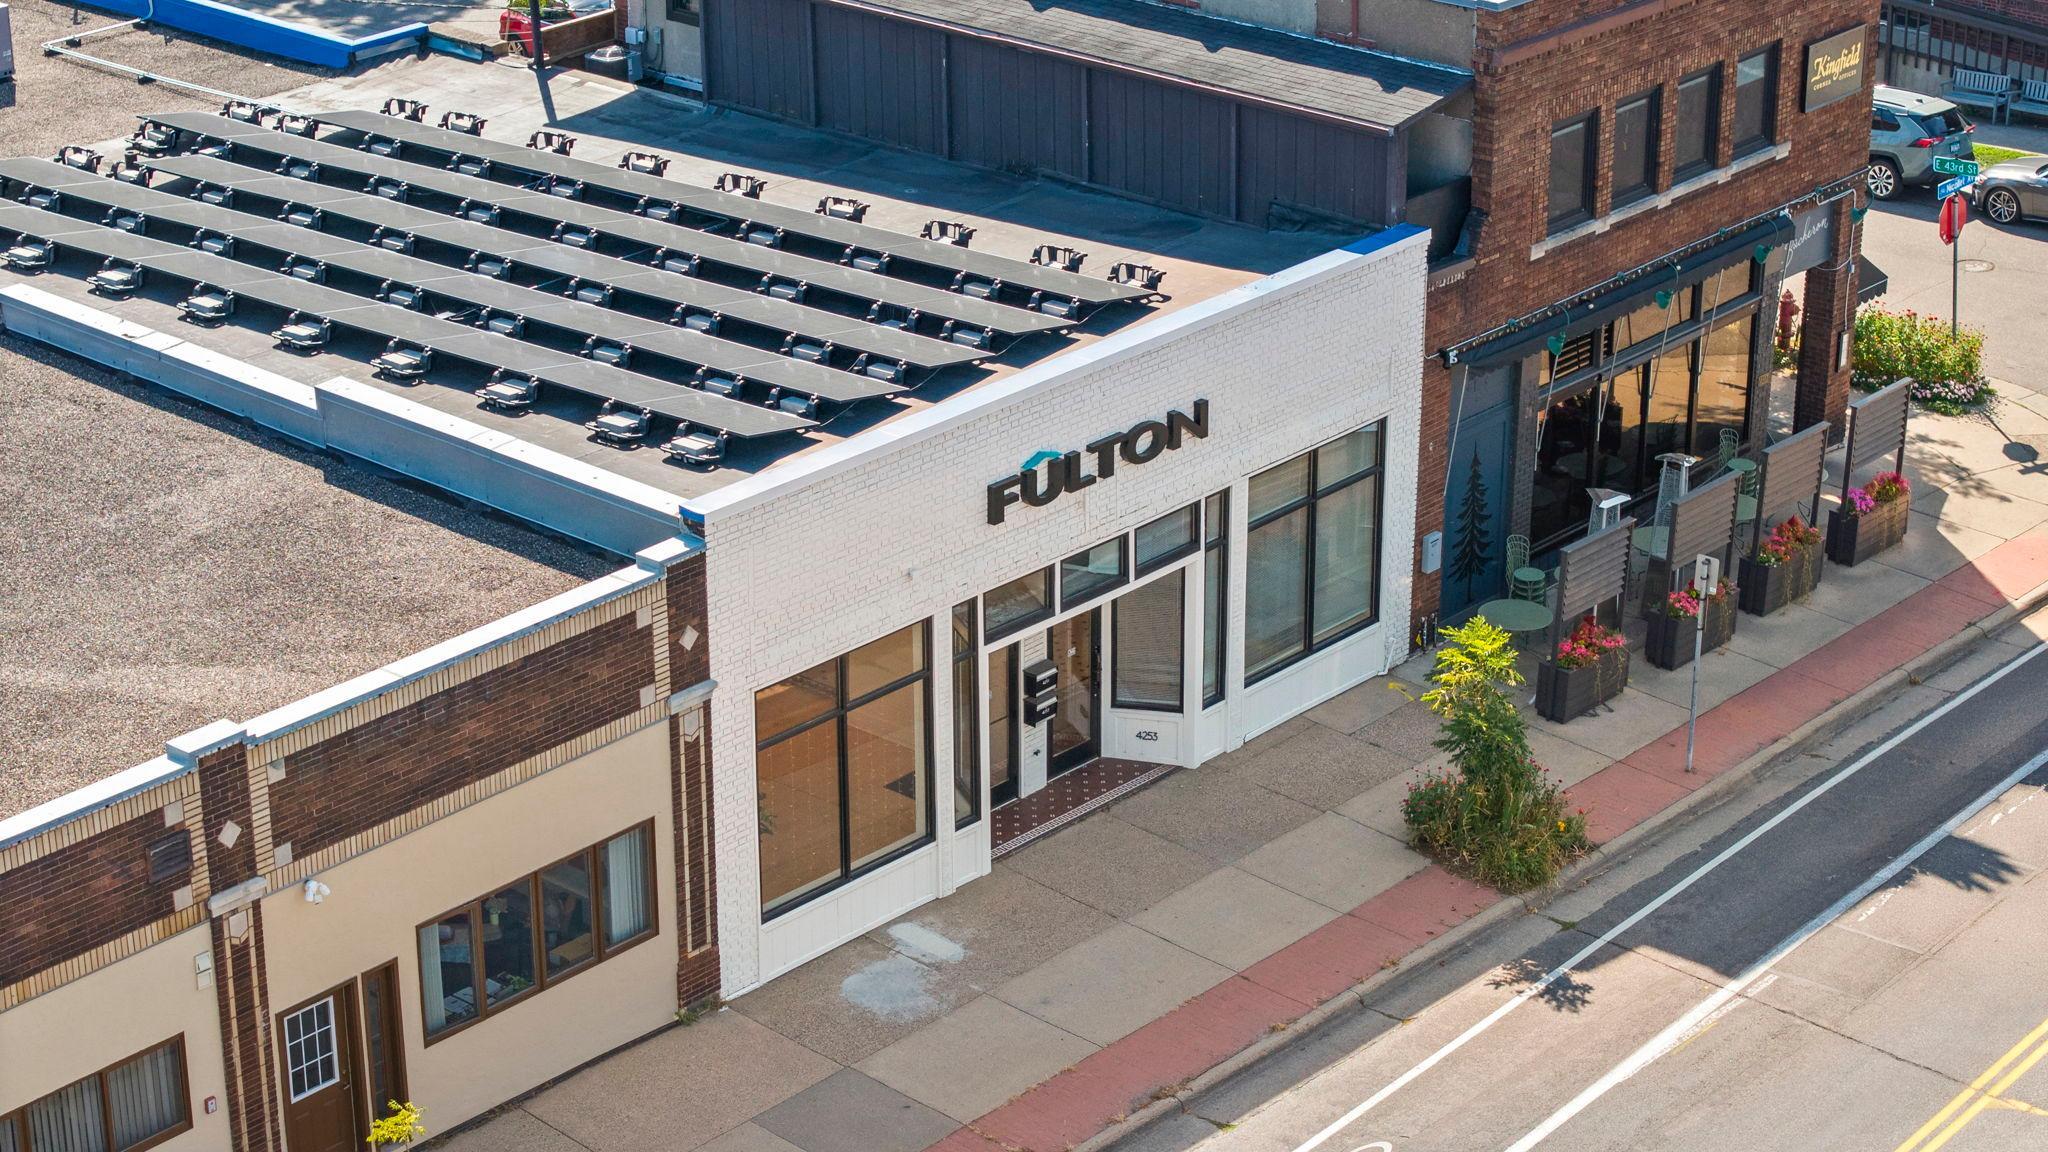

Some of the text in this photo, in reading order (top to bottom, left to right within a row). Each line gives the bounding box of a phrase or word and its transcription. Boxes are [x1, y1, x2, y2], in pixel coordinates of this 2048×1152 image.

[1811, 42, 1861, 82] Kingfield
[1936, 160, 1977, 175] E 43rd St
[987, 398, 1209, 525] FULTON
[1135, 731, 1158, 741] 4253
